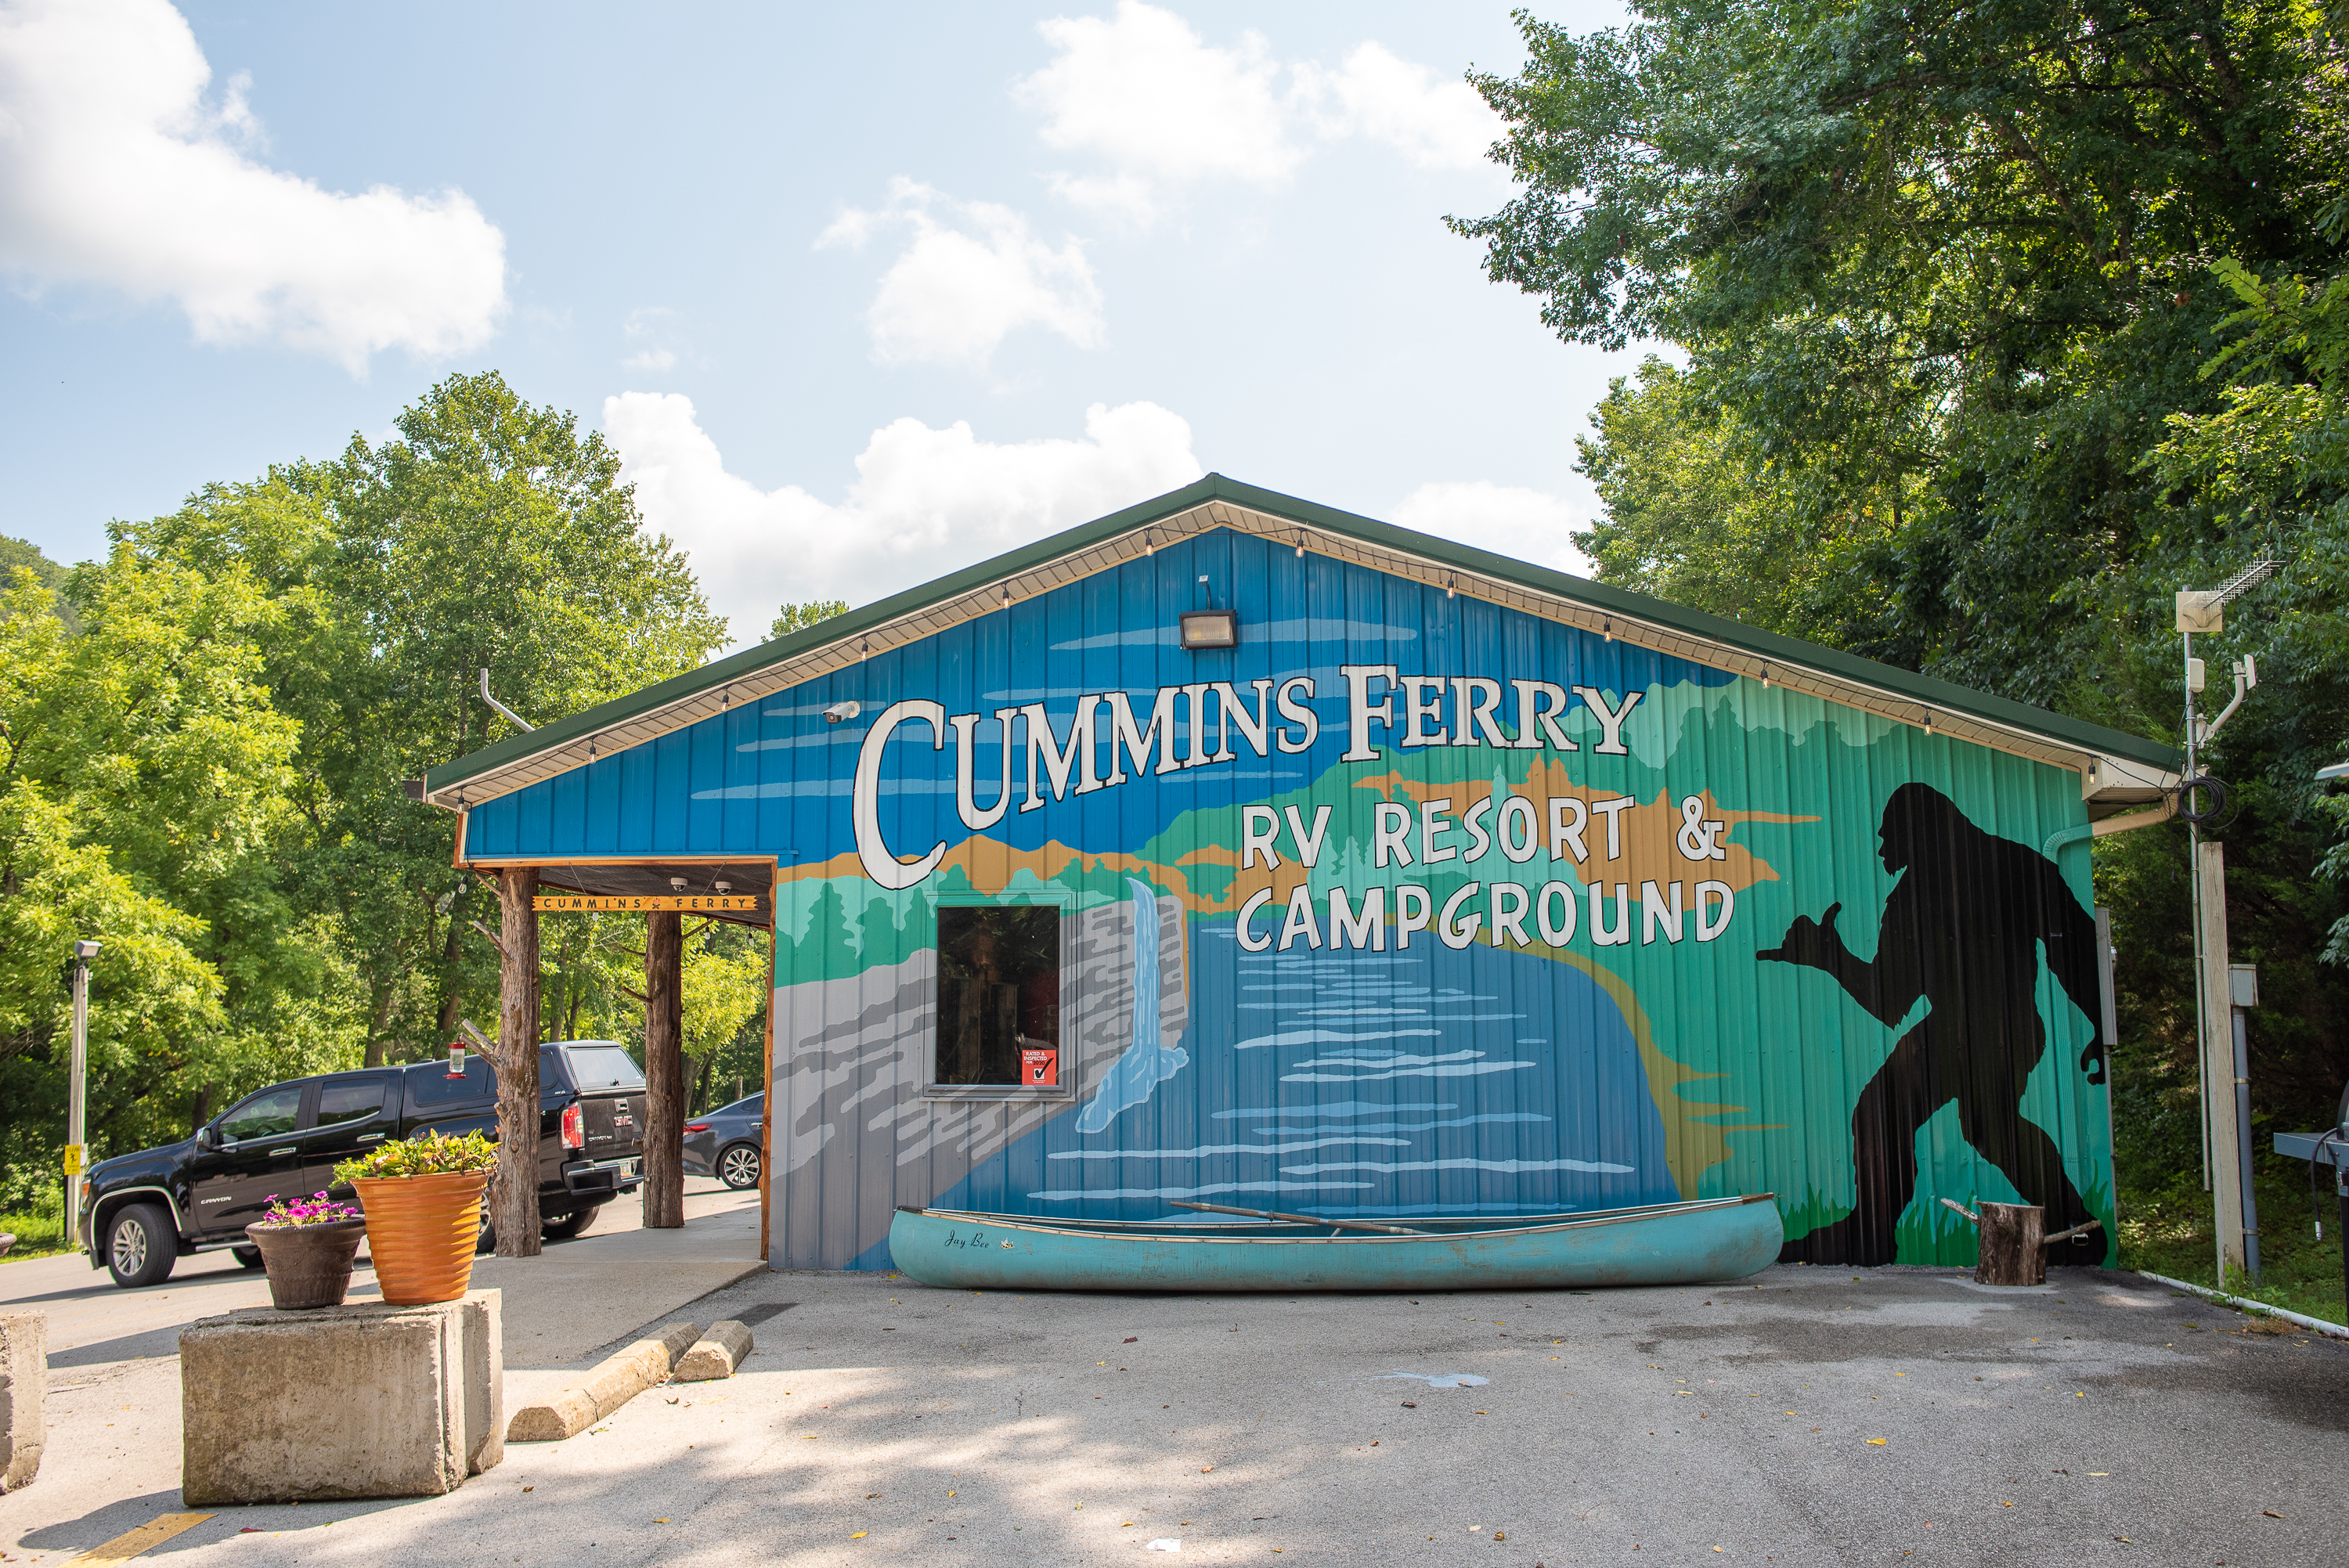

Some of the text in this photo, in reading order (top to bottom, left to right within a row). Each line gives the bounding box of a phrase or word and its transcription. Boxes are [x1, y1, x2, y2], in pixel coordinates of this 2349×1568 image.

[853, 663, 1645, 890] CUMMINS FERRY
[1242, 795, 1727, 872] RV RESORT &
[543, 897, 746, 909] CUMMINS FERRY
[1235, 879, 1736, 953] CAMPGROUND
[613, 1115, 633, 1126] GMC
[200, 1195, 233, 1205] CANYON
[944, 1229, 990, 1249] Jay Bee
